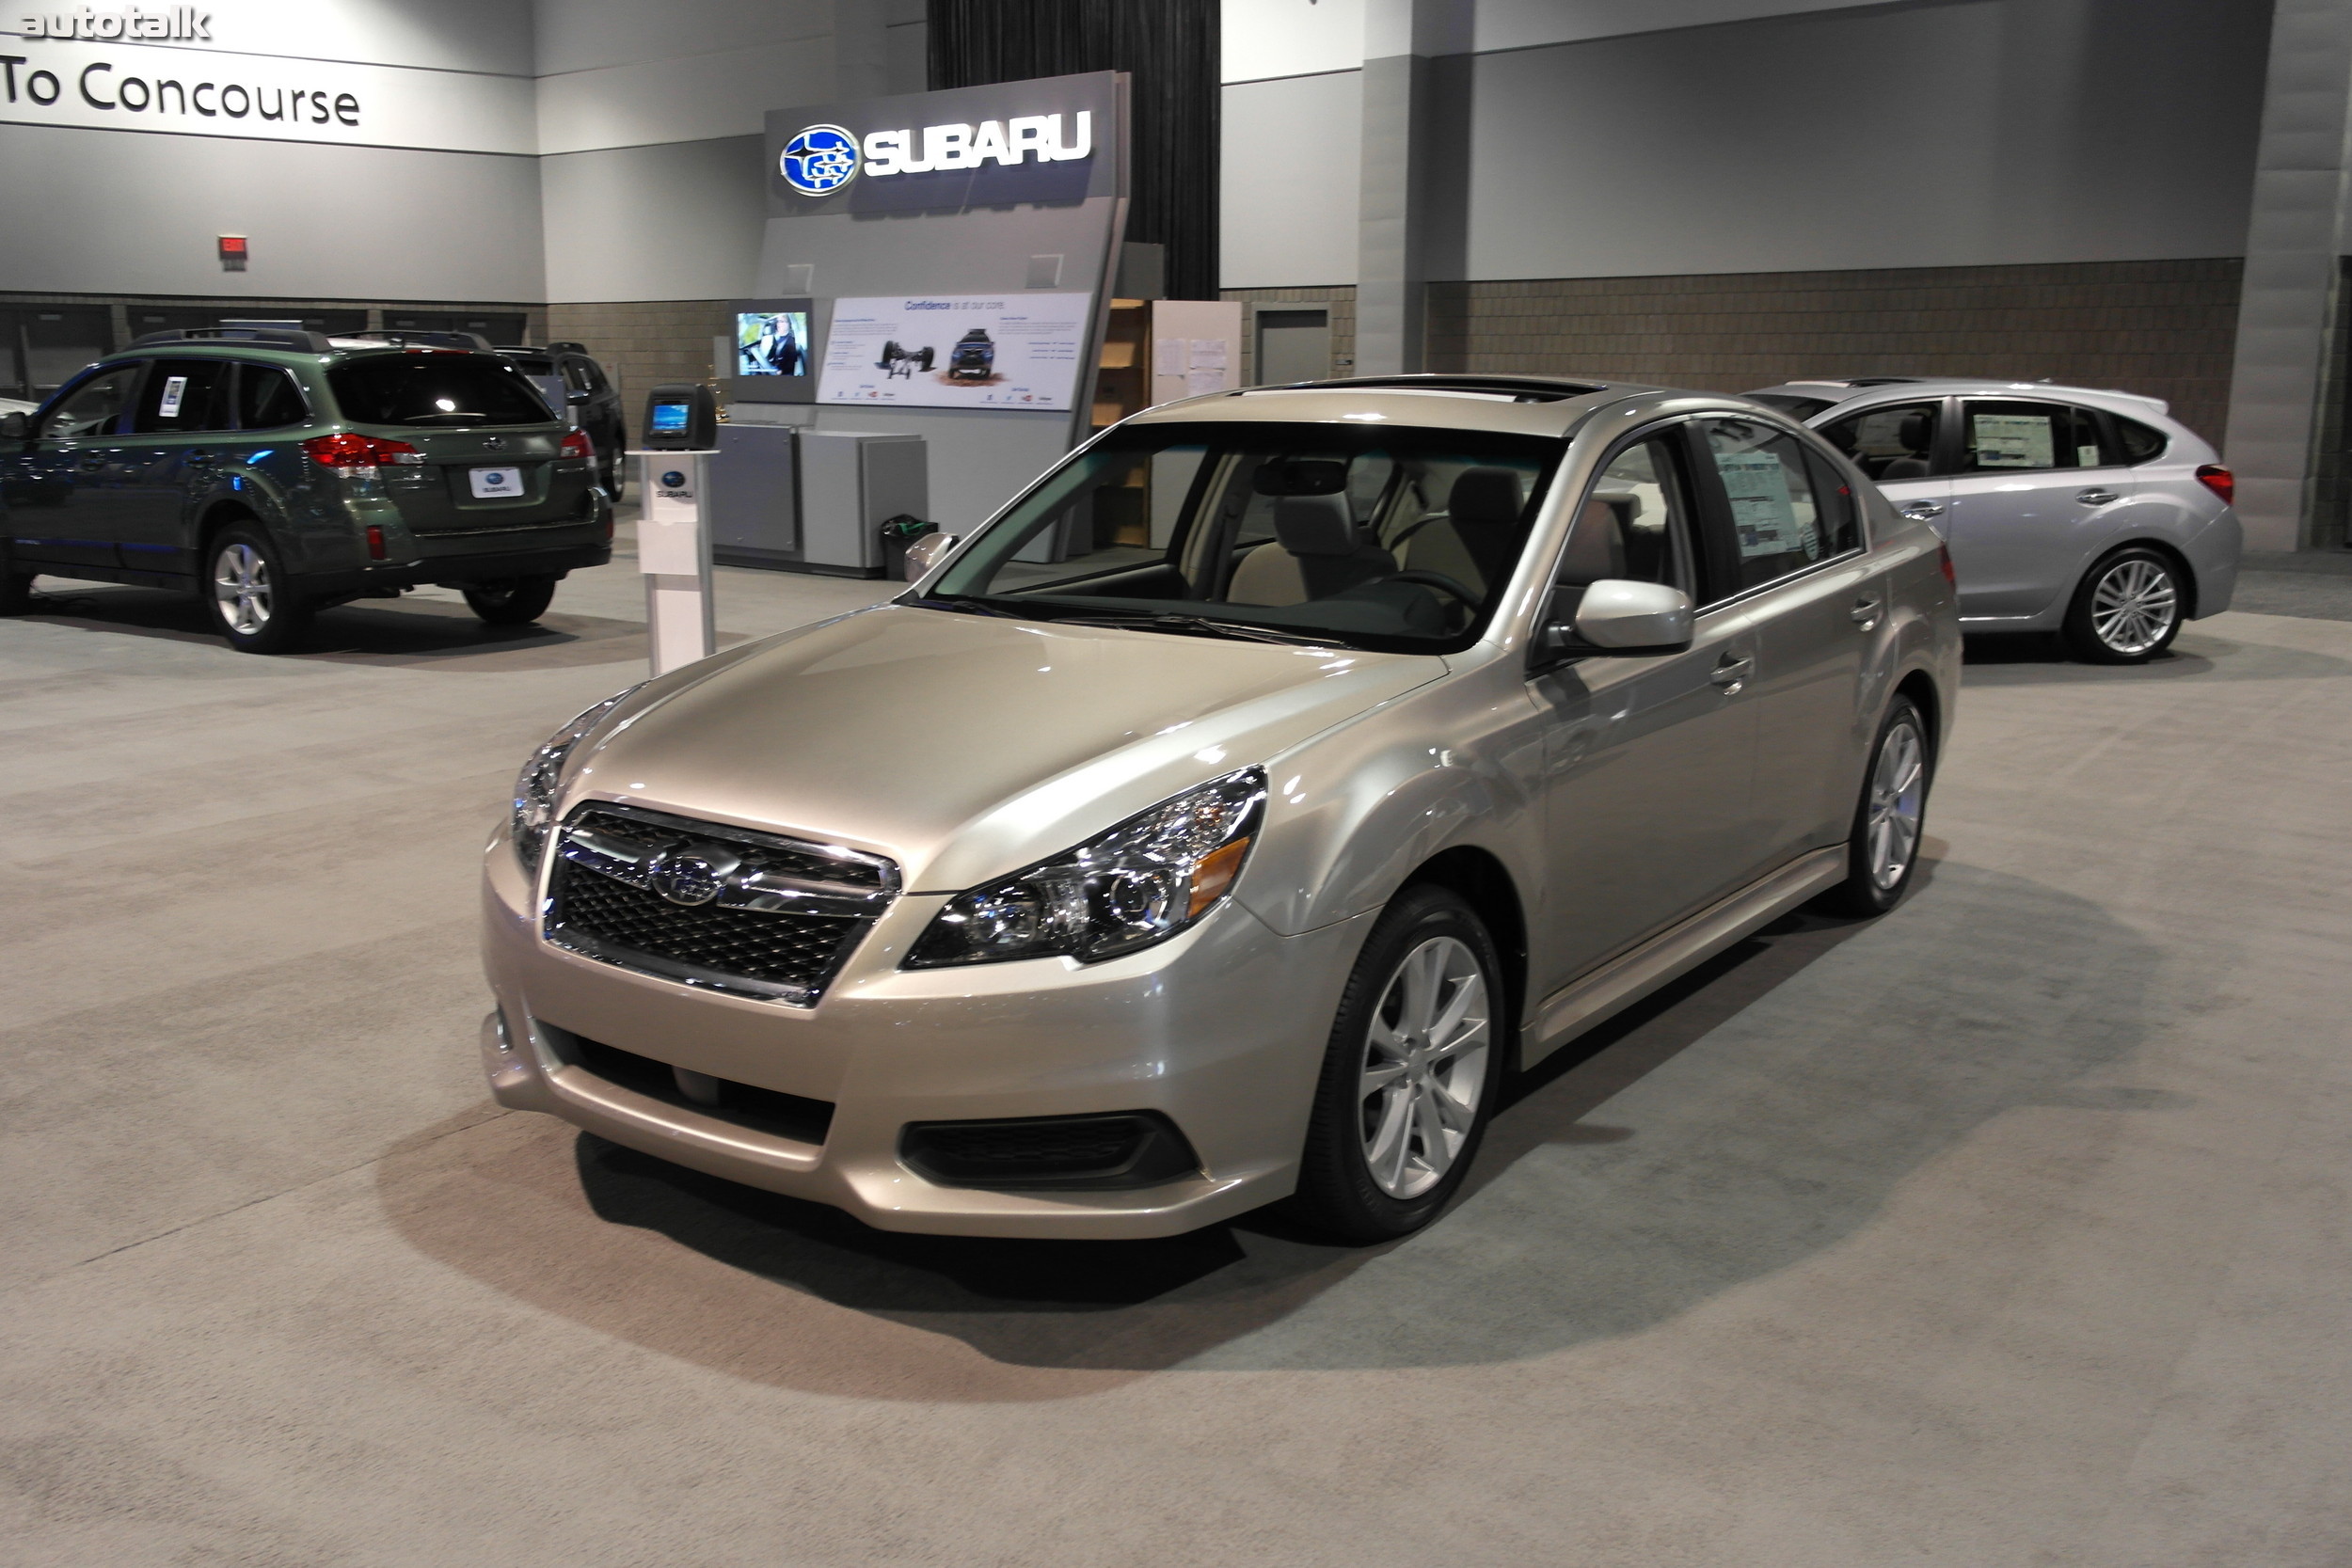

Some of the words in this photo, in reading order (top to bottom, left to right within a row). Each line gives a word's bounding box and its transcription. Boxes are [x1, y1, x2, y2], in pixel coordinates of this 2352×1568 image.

[0, 55, 60, 106] To
[80, 62, 360, 126] Concourse
[864, 110, 1091, 177] SUBARU
[904, 301, 950, 310] Confidence
[656, 490, 692, 499] SUBARU
